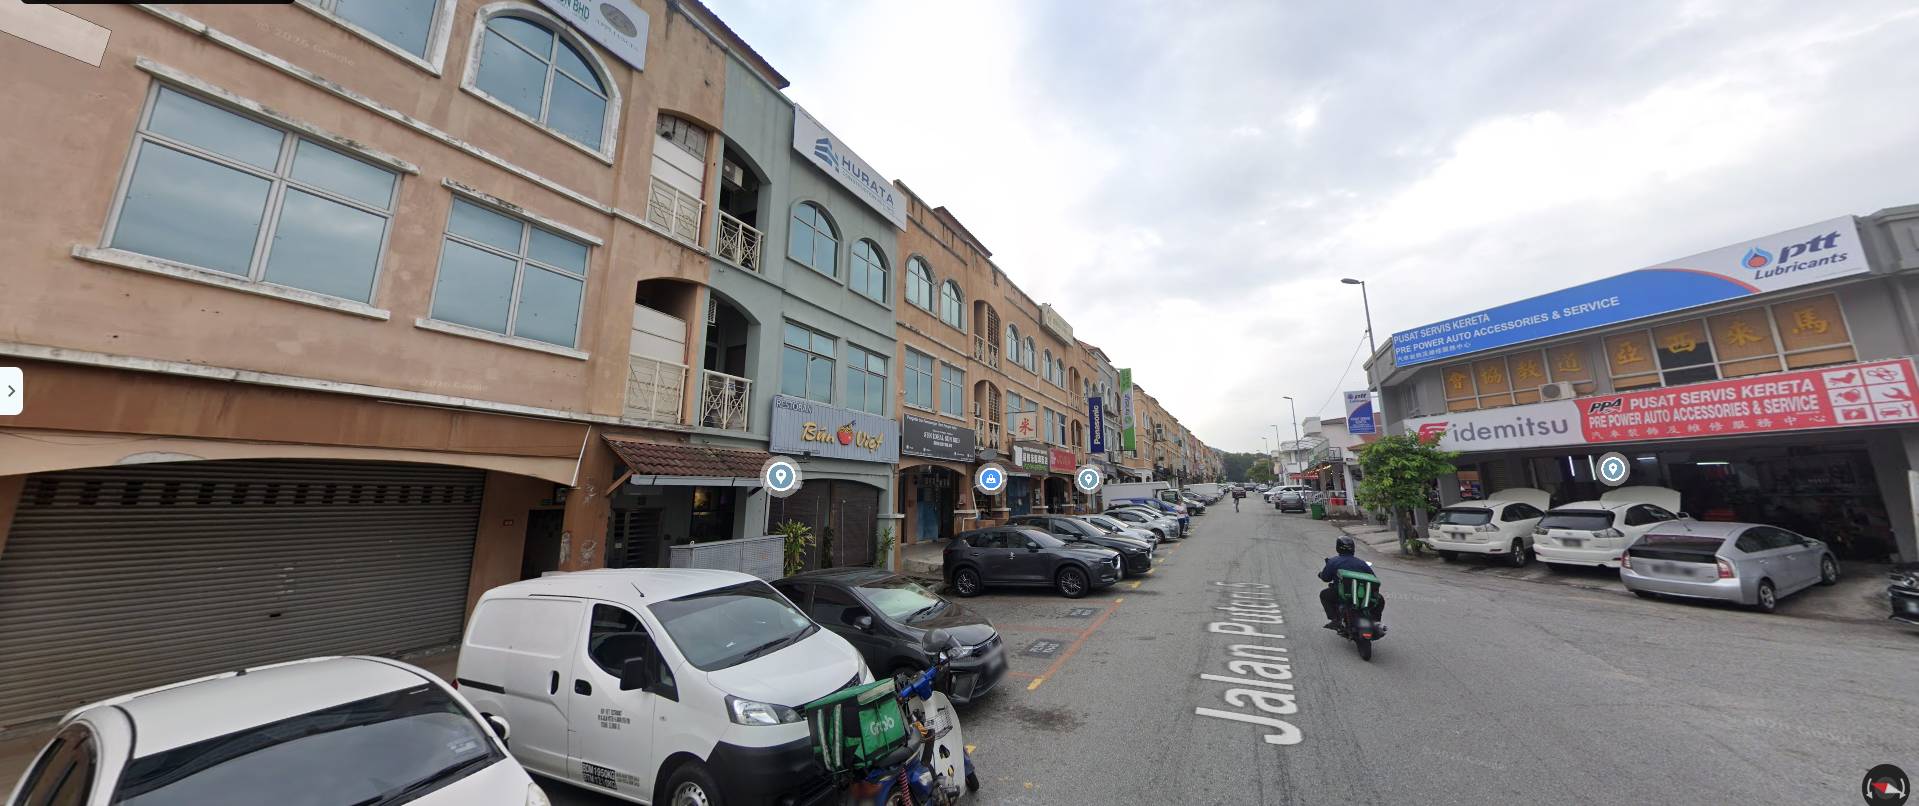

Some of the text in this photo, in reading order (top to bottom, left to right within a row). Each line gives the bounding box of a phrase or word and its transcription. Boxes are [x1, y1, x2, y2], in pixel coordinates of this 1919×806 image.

[842, 155, 895, 206] HURATA
[1778, 230, 1842, 264] ptt
[1754, 252, 1848, 279] Lubricants
[1394, 313, 1490, 344] PUSAT SERVIS KERETA
[1396, 296, 1620, 354] PRE POWER AUTO ACCESSORIES & SERVICE
[776, 399, 813, 414] RESTORAN
[1630, 394, 1677, 410] PUSAT
[1680, 386, 1736, 405] SERVIS
[1741, 379, 1815, 399] KERETA
[1093, 404, 1101, 445] Panasonic
[1589, 394, 1819, 429] PRE POWER AUTO ACCESSORIES & SERVICE
[1452, 417, 1569, 442] idemitsu
